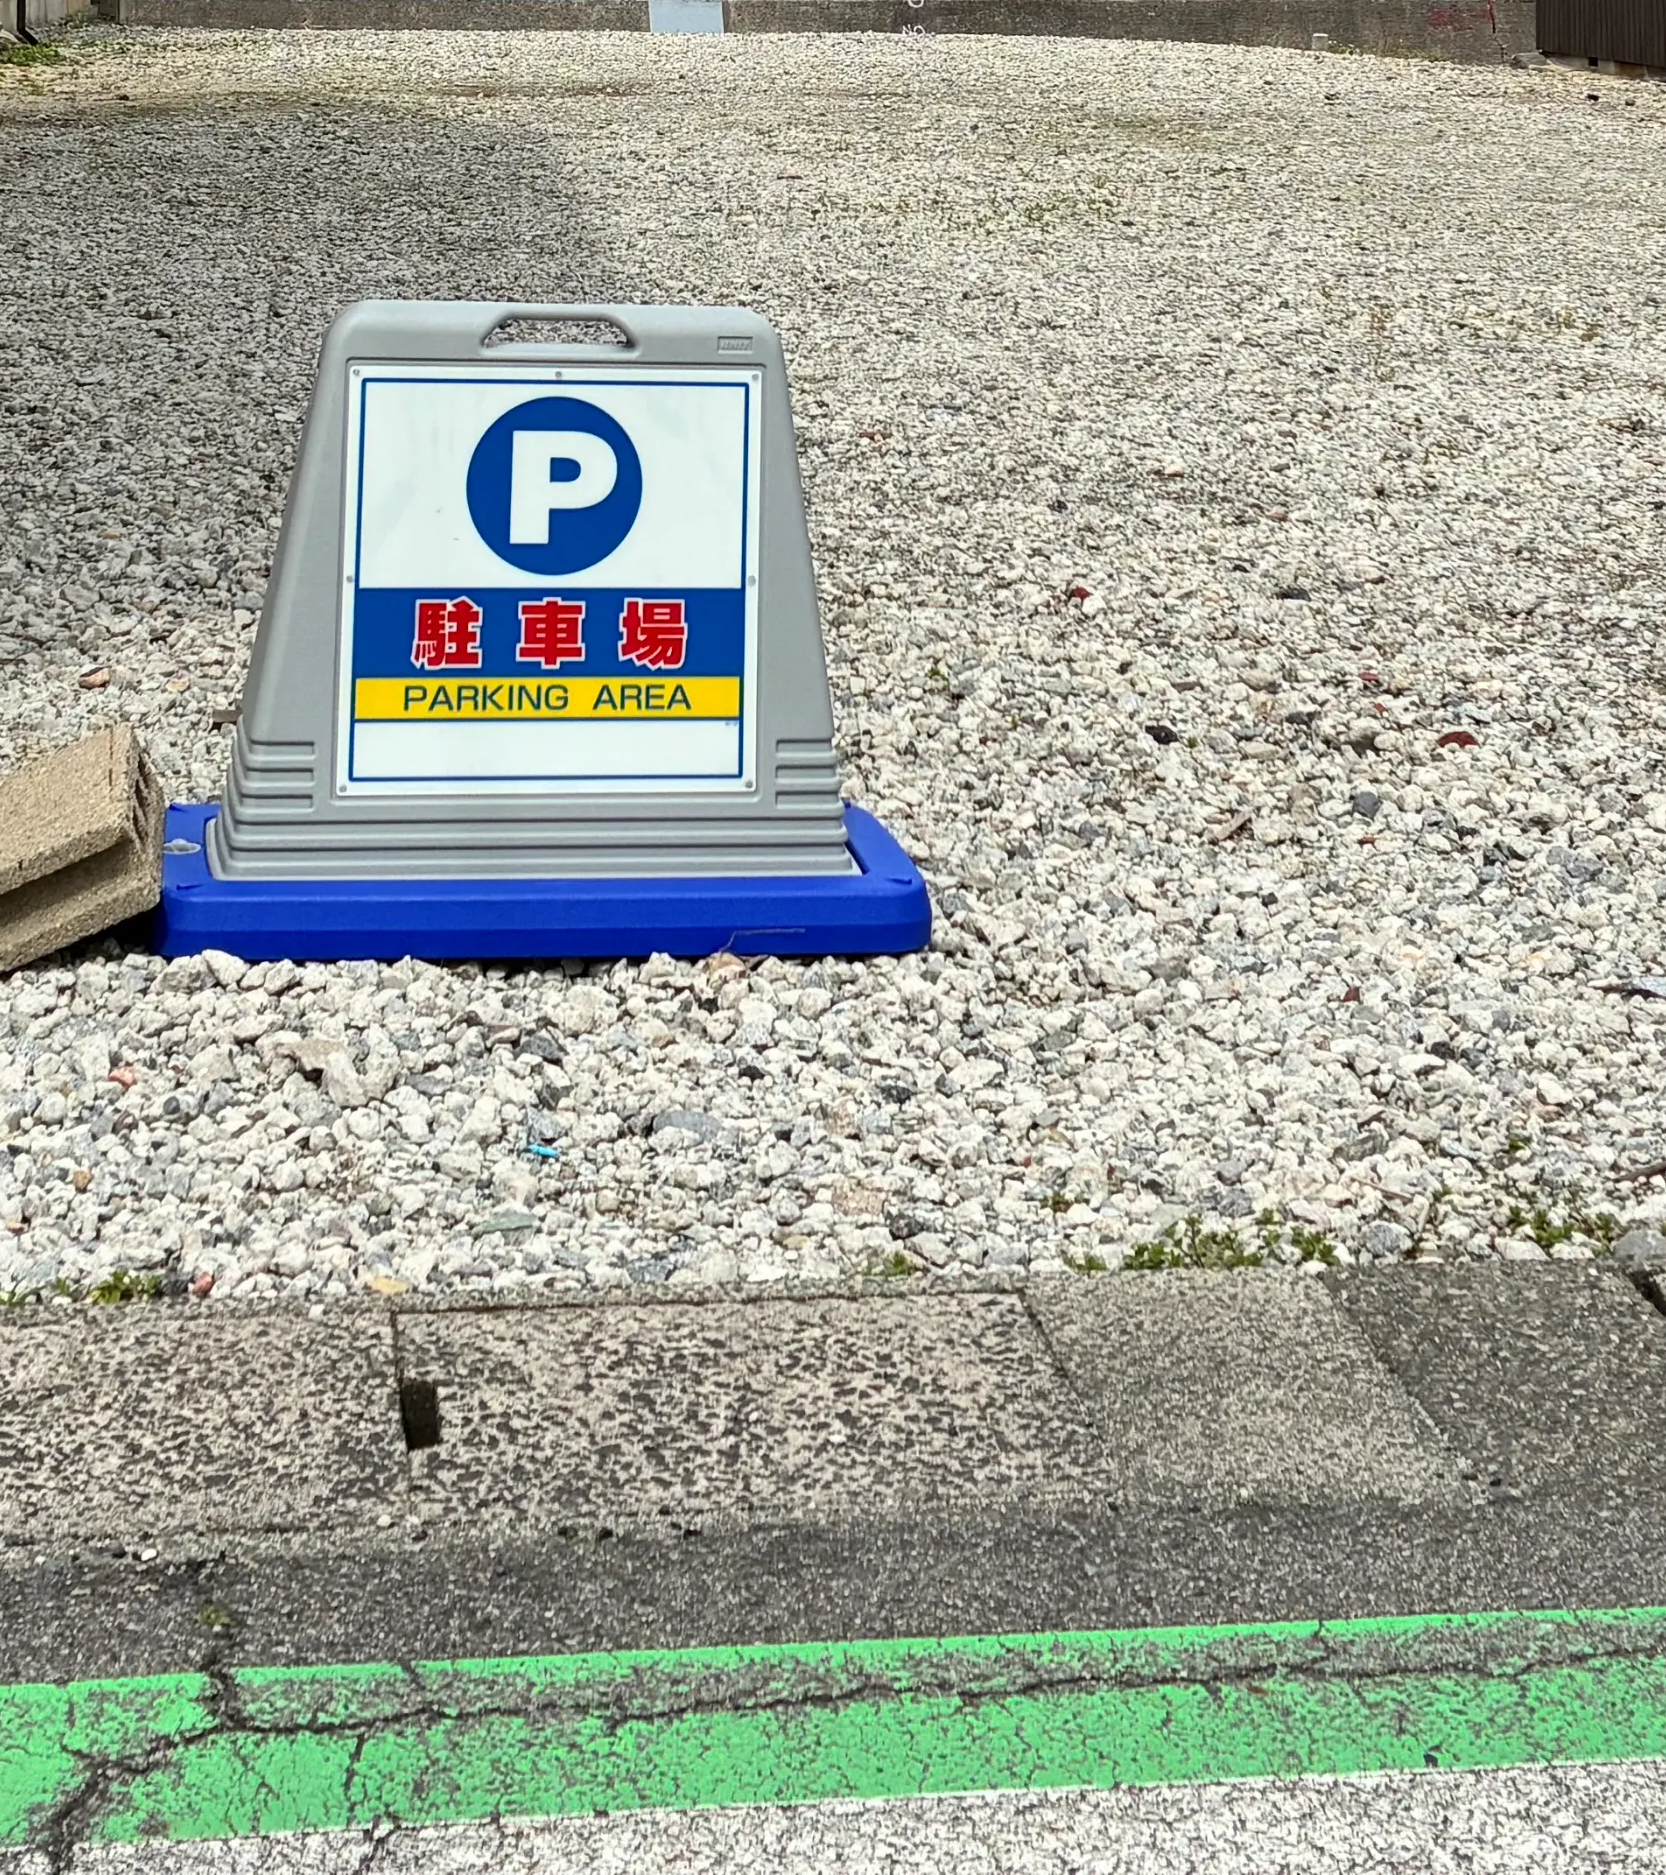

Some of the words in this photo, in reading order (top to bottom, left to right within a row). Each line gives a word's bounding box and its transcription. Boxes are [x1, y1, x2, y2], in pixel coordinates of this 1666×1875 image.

[510, 430, 618, 544] P
[410, 595, 687, 671] 駐車場
[403, 685, 569, 711] PARKING
[592, 684, 692, 711] AREA
